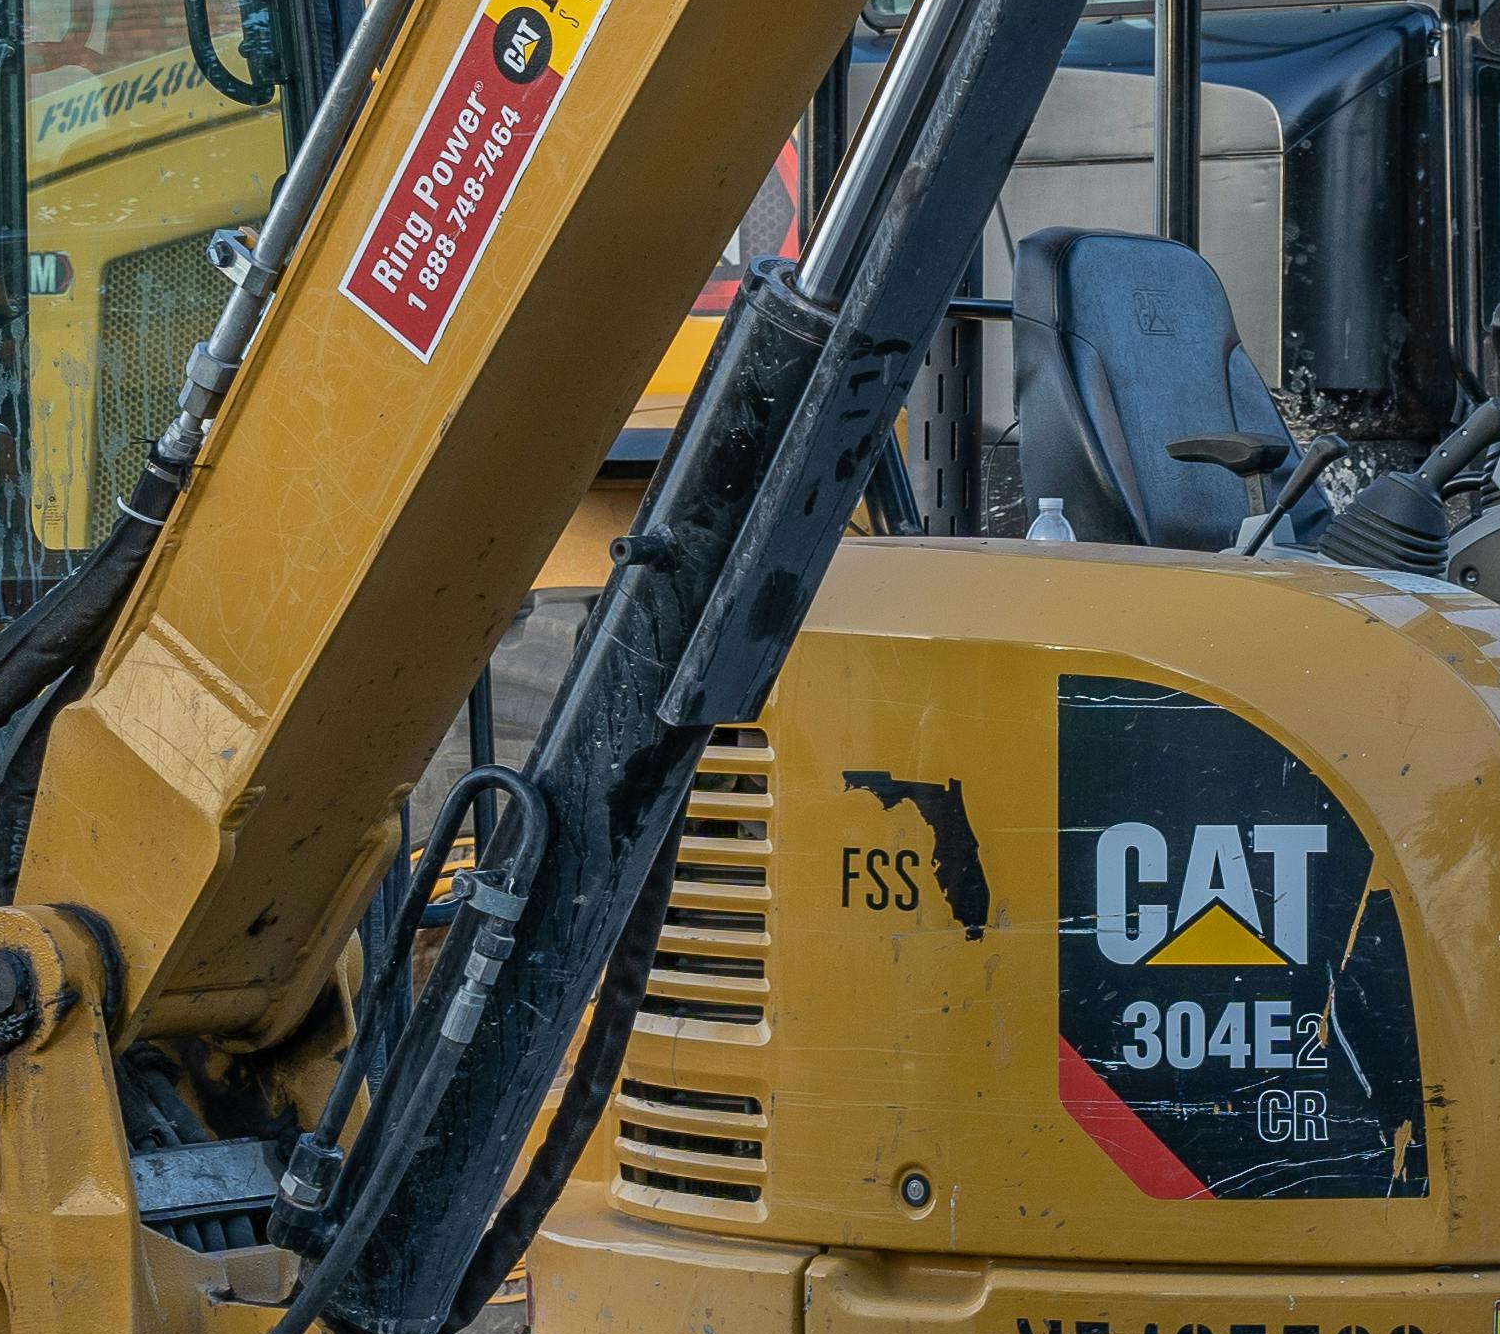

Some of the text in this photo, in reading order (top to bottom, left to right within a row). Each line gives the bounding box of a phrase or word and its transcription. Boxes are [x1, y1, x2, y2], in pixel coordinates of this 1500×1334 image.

[503, 18, 542, 73] CAT
[371, 210, 434, 294] Ring
[407, 292, 428, 312] 1
[418, 233, 457, 291] 888
[841, 847, 920, 911] FSS
[1096, 822, 1328, 965] CAT
[1122, 1000, 1329, 1070] 304E2
[1257, 1089, 1329, 1142] CR
